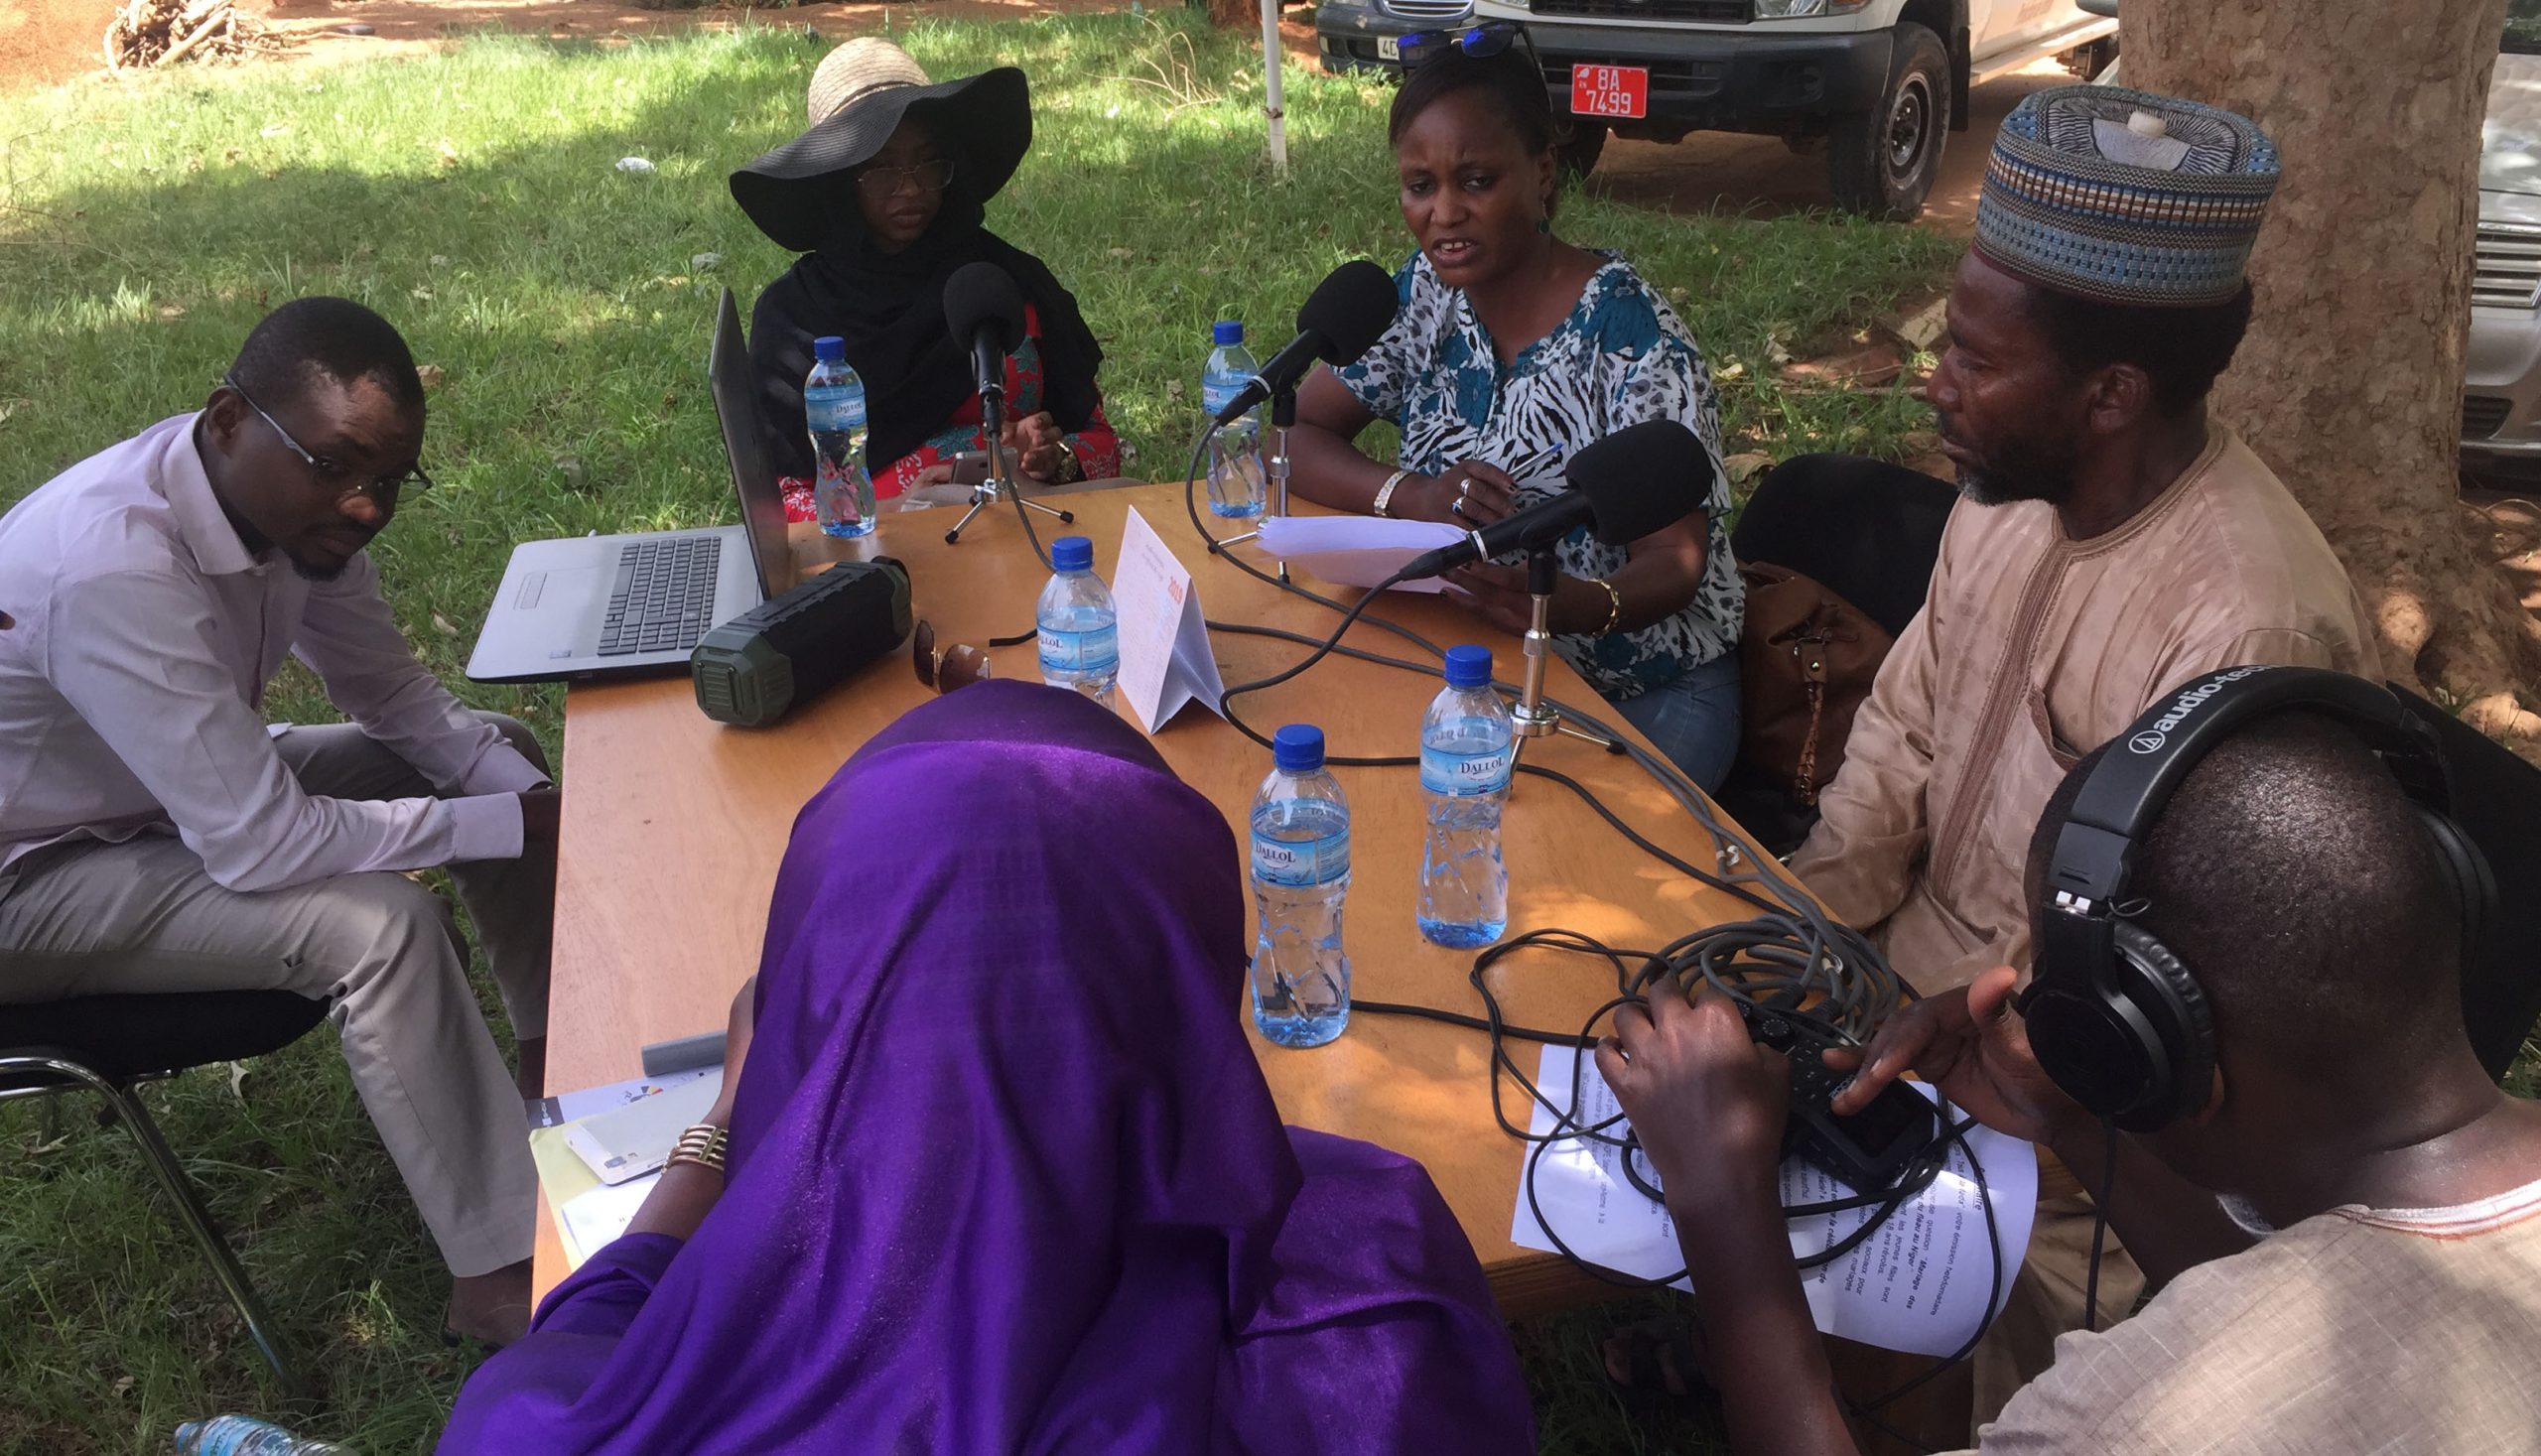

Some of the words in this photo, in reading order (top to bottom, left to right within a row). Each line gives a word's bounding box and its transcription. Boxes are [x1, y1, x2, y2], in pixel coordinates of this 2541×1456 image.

[1597, 68, 1620, 91] 8A
[1586, 89, 1632, 114] 7499
[2153, 665, 2273, 732] audio-tec
[1461, 757, 1504, 774] DALLOL
[1256, 842, 1295, 862] DALLOL
[1886, 1222, 1894, 1232] 18
[1954, 1212, 1964, 1231] votre
[1912, 1234, 1920, 1243] au
[1923, 1219, 1934, 1252] question
[1892, 1234, 1903, 1261] jeunes
[1946, 1232, 1960, 1265] émission
[1860, 1246, 1873, 1273] sociaux
[1818, 1271, 1827, 1284] de
[1845, 1257, 1858, 1292] mariages
[1887, 1265, 1898, 1282] filles
[1856, 1277, 1866, 1296] pour
[1881, 1286, 1891, 1303] sont
[1930, 1266, 1952, 1316] hebdomadaire
[1906, 1294, 1916, 1309] des
